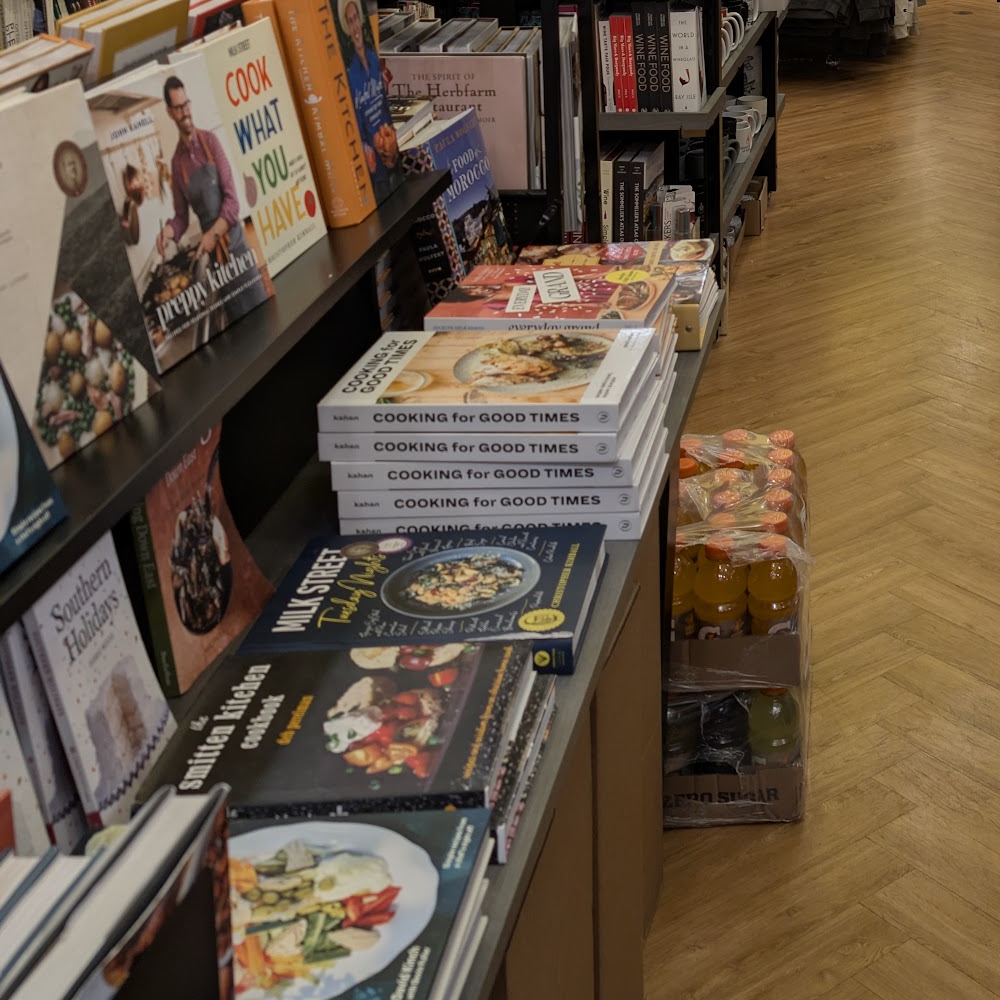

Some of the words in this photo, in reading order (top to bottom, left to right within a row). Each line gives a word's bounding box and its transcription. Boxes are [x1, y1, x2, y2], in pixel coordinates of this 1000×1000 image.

[635, 34, 646, 61] WINE
[647, 34, 657, 62] WINE
[660, 35, 669, 62] WINE
[225, 56, 273, 107] COOK
[392, 84, 422, 98] The
[427, 83, 497, 98] Herbfarm
[433, 73, 460, 81] SPIRIT
[637, 62, 647, 92] FOOD
[649, 62, 659, 92] FOOD
[661, 64, 671, 93] FOOD
[318, 5, 338, 59] THE
[334, 72, 370, 206] KITCHEN
[433, 104, 483, 112] taurant
[233, 98, 284, 155] WHAT
[252, 145, 289, 196] YOU
[452, 150, 475, 173] FOOD
[447, 156, 491, 203] MOROCCO
[257, 185, 306, 247] HAVE
[155, 278, 208, 331] preppy
[208, 249, 258, 288] kitchen
[342, 347, 389, 394] COOKING
[386, 339, 401, 351] for
[360, 362, 396, 394] GOOD
[390, 338, 419, 365] TIMES
[373, 412, 448, 424] COOKING
[452, 411, 476, 424] for
[479, 412, 526, 424] GOOD
[530, 411, 580, 423] TIMES
[374, 441, 448, 453] COOKING
[452, 441, 476, 453] for
[477, 442, 525, 454] GOOD
[529, 442, 579, 454] TIMES
[387, 469, 463, 480] COOKING
[467, 469, 490, 480] for
[494, 468, 541, 480] GOOD
[544, 468, 595, 478] TIMES
[394, 498, 470, 509] COOKING
[473, 497, 498, 508] for
[500, 496, 548, 508] GOOD
[551, 495, 601, 506] TIMES
[355, 528, 382, 536] kahan
[396, 525, 471, 536] COOKING
[475, 524, 498, 534] for
[297, 549, 350, 595] STREET
[337, 554, 390, 590] Nights
[552, 568, 568, 608] CHRISTOPHER
[50, 558, 113, 633] Southern
[316, 587, 378, 628] Tuesday
[64, 594, 122, 666] Holidays
[271, 598, 325, 633] MILK
[179, 713, 235, 793] smitten
[226, 664, 272, 728] kitchen
[190, 715, 210, 732] the
[240, 694, 286, 752] cookbook
